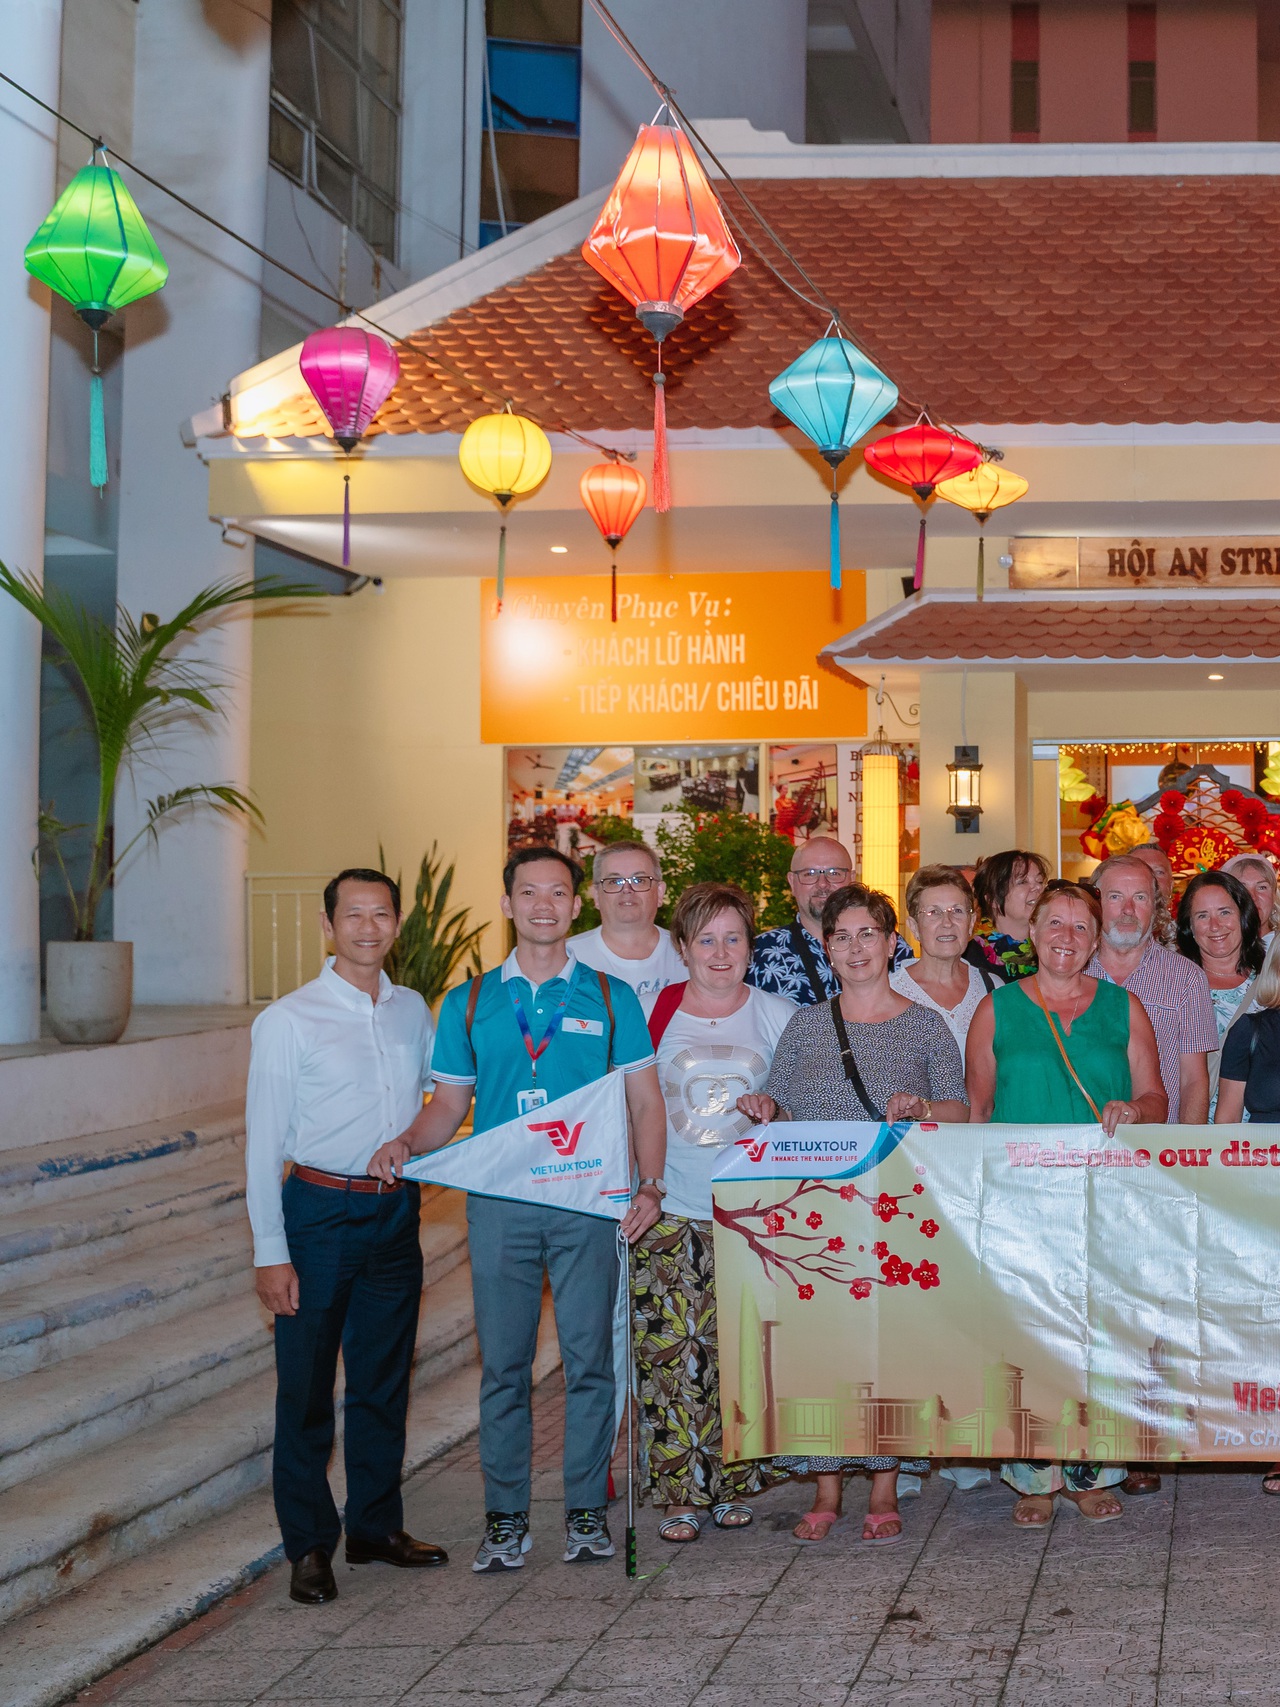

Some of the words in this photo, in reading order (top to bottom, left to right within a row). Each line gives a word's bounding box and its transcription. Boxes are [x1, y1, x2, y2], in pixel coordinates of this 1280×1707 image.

[1107, 538, 1156, 585] HỘI
[1168, 547, 1208, 577] AN
[510, 594, 605, 625] Chuyên
[615, 592, 679, 627] Phục
[688, 591, 732, 626] Vụ:
[578, 631, 649, 667] KHÁCH
[656, 626, 682, 666] LỮ
[687, 629, 745, 664] HÀNH
[578, 676, 621, 713] TIẾP
[627, 678, 711, 713] KHÁCH/
[717, 675, 778, 711] CHIÊU
[783, 675, 818, 710] ĐÃI
[772, 1141, 857, 1152] VIETLUXTOUR
[1004, 1141, 1151, 1168] Welcome
[1158, 1147, 1212, 1168] our
[530, 1157, 603, 1176] VIETLUXTOUR
[1213, 1429, 1245, 1446] Ho
